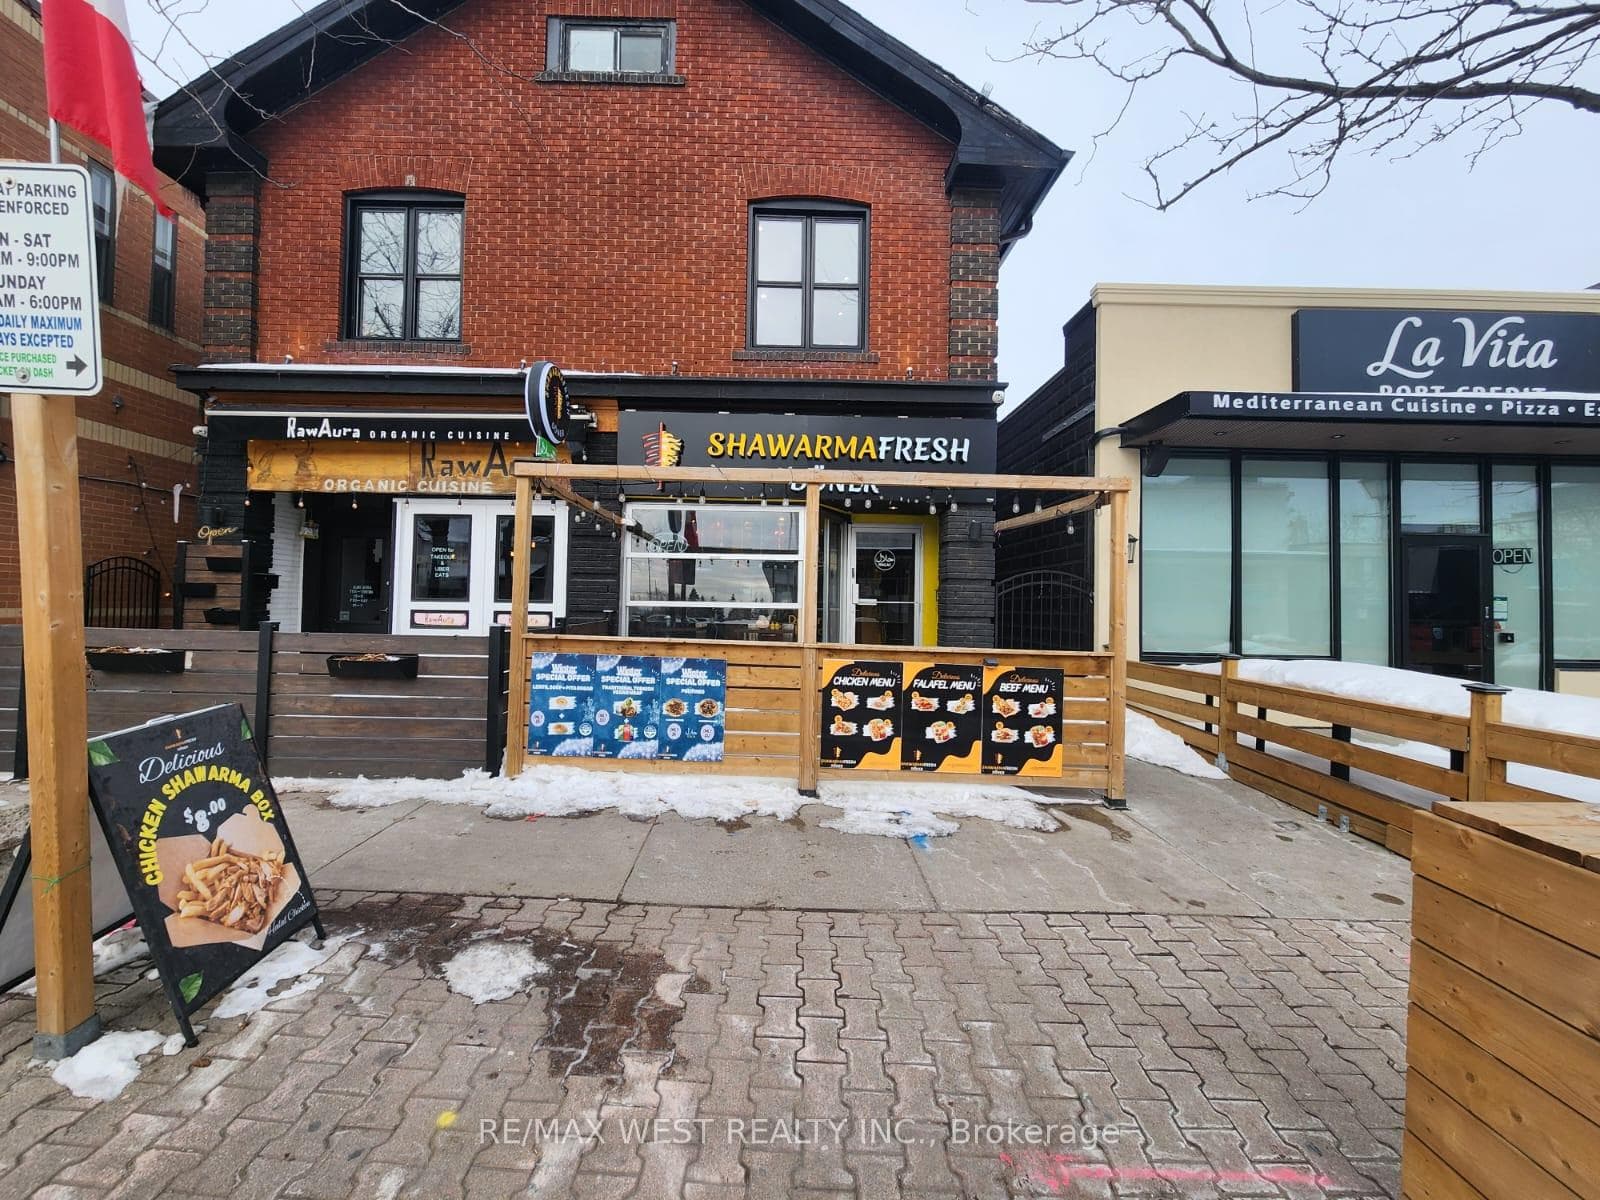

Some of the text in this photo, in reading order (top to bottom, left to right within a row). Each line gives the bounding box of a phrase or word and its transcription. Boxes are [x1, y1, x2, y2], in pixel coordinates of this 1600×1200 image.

[17, 183, 77, 198] PARKING
[0, 200, 70, 215] ENFORCED
[24, 233, 51, 247] SAT
[27, 252, 79, 268] 9:00PM
[30, 295, 82, 310] 6:00PM
[31, 316, 82, 330] MAXIMUM
[20, 333, 74, 348] EXCEPTED
[1366, 316, 1558, 379] La Vita
[11, 353, 57, 364] PURCHASED
[33, 368, 54, 378] DASH
[1213, 394, 1384, 412] Mediterranean
[1390, 398, 1476, 414] Cuisine
[1502, 400, 1560, 416] Pizza
[286, 417, 510, 440] RawAura ORGANIC CUISINE
[707, 432, 971, 464] SHAWARMAFRESH
[421, 441, 514, 478] RawA
[324, 479, 494, 493] ORGANIC CUISINE
[197, 525, 239, 545] Open
[1492, 548, 1533, 564] OPEN
[535, 673, 591, 682] SPECIAL OFFER
[601, 675, 656, 684] SPECIAL OFFER
[666, 677, 721, 687] SPECIAL OFFER
[833, 676, 896, 687] CHICKEN MENU
[913, 679, 977, 690] FALAFEL MENU
[999, 682, 1049, 694] BEEF MENU
[138, 742, 225, 784] Delicious
[138, 765, 275, 886] CHICKEN SHAWARMA BOX
